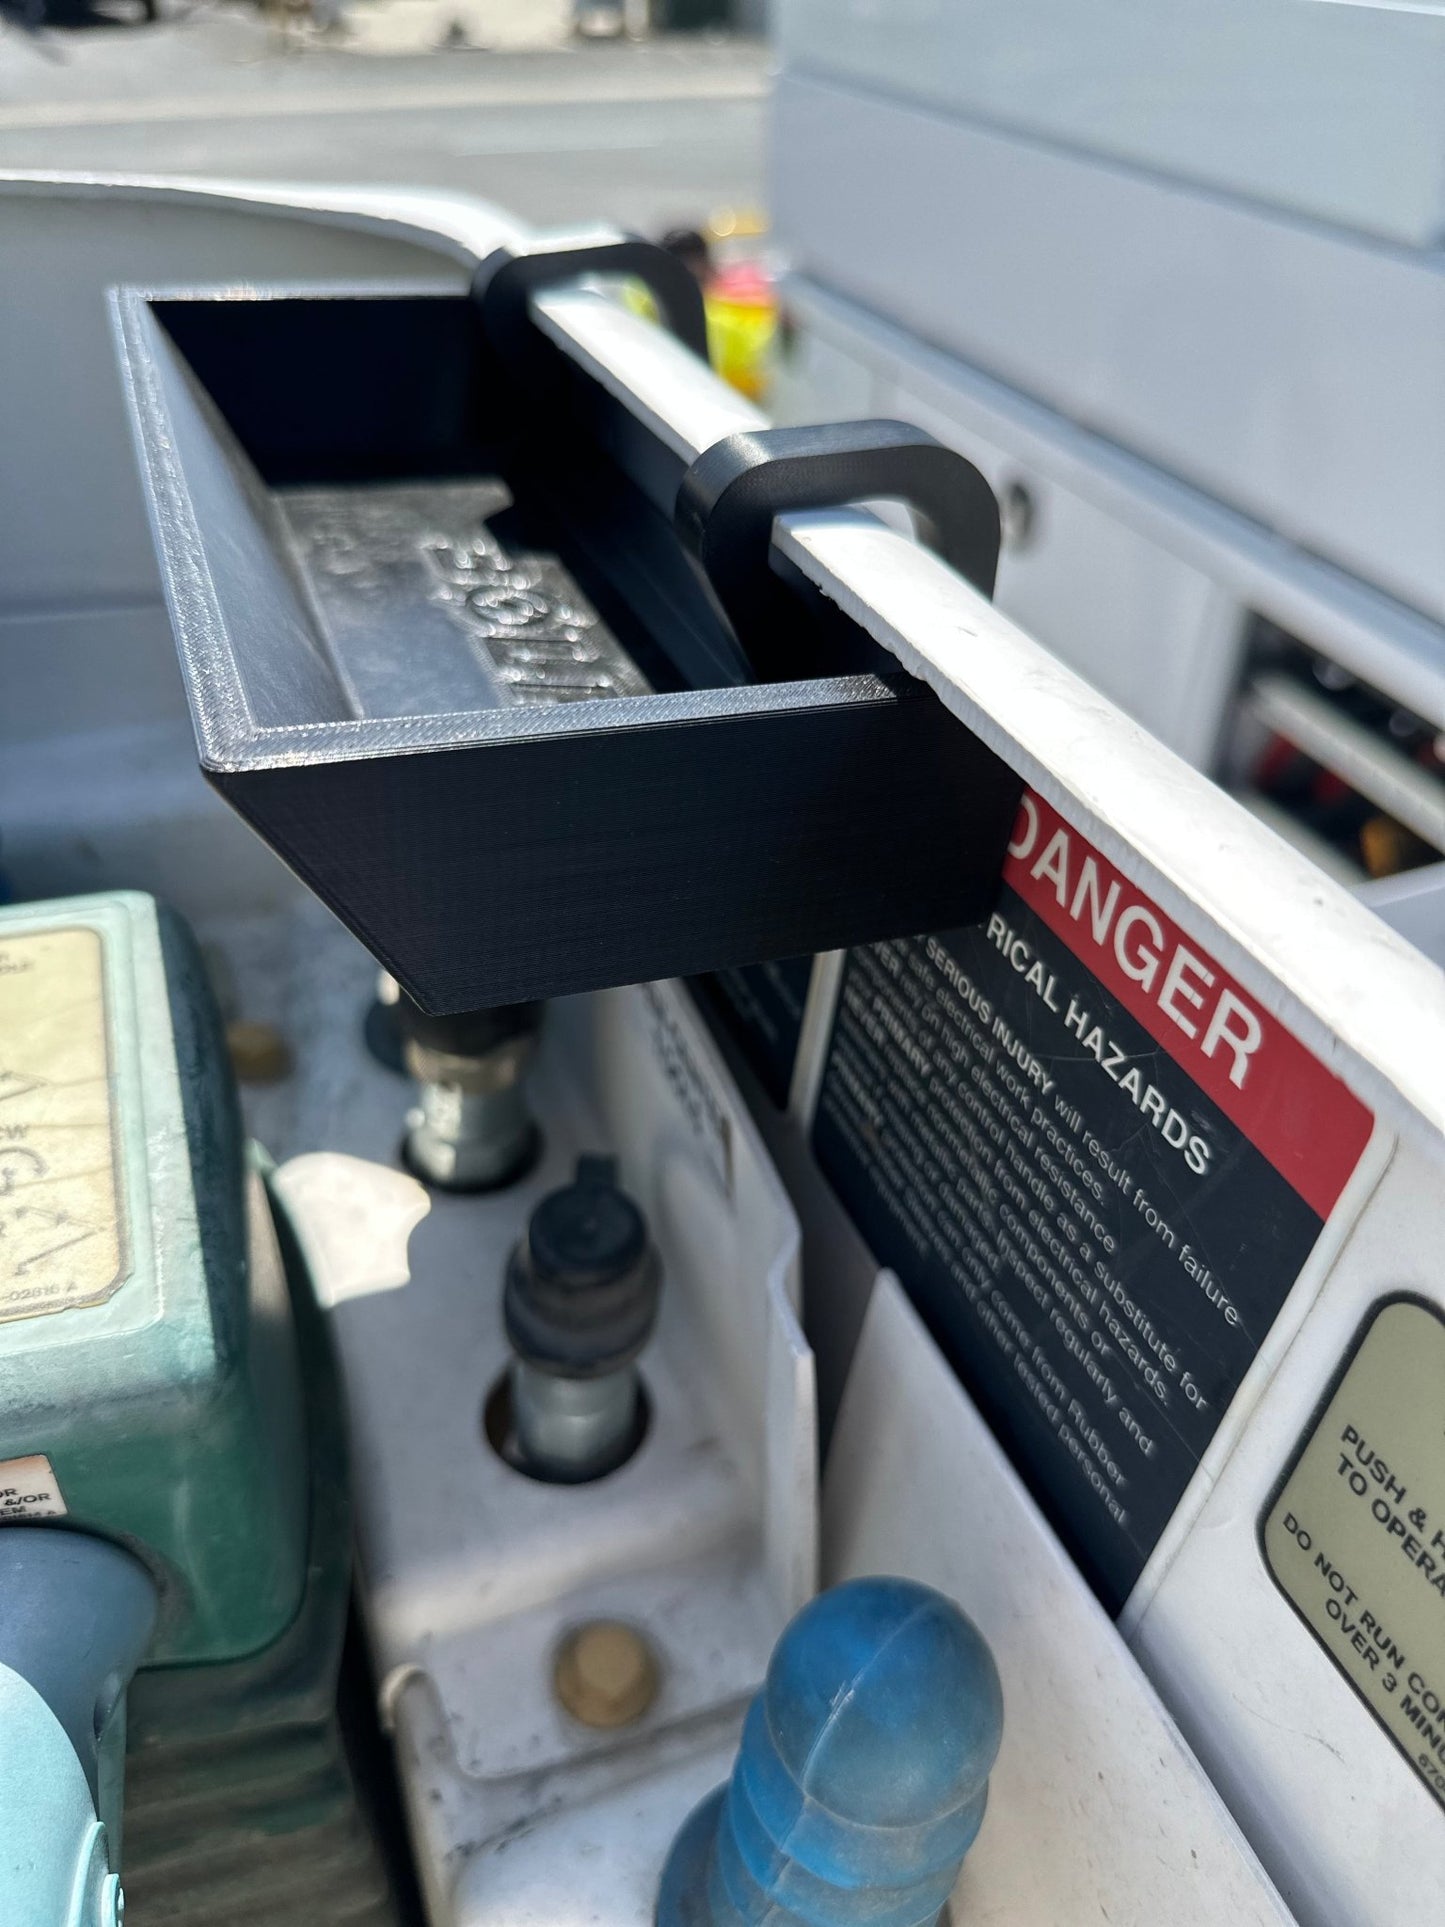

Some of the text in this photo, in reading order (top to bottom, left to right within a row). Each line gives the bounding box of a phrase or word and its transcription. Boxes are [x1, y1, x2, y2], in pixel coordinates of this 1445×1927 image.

[987, 914, 1210, 1174] RICAL HAZARDS
[1008, 794, 1263, 1090] DANGER
[873, 997, 930, 1075] PRIMARY
[929, 1077, 994, 1164] protection
[994, 1159, 1027, 1210] from
[1029, 1210, 1098, 1304] electrical
[1099, 1300, 1167, 1406] hazards.
[909, 954, 1104, 1206] safe electrical work practices.
[921, 1003, 941, 1030] on
[941, 1024, 970, 1068] high
[971, 1066, 1034, 1148] electrical
[1034, 1146, 1116, 1253] resistance
[928, 938, 1240, 1326] SERIOUS INJURY will result from failure
[918, 1030, 935, 1051] of
[932, 1050, 958, 1085] any
[958, 1082, 1005, 1145] control
[1005, 1140, 1055, 1212] handle
[1057, 1213, 1077, 1242] as
[1079, 1242, 1092, 1262] a
[1094, 1261, 1177, 1373] substitute
[1180, 1371, 1207, 1409] for
[927, 1104, 998, 1206] nonmetallic
[1000, 1204, 1090, 1330] components
[1091, 1331, 1111, 1355] or
[962, 1247, 992, 1291] only
[991, 1290, 1032, 1348] come
[1032, 1346, 1067, 1401] from
[1068, 1399, 1125, 1485] Rubber
[977, 1301, 1014, 1352] other
[1014, 1353, 1061, 1423] tested
[1058, 1423, 1126, 1525] personal
[996, 1229, 1050, 1309] Inspect
[1050, 1308, 1118, 1405] regularly
[1119, 1407, 1154, 1456] and
[5, 1493, 52, 1505] &/OR
[1283, 1512, 1312, 1551] DO
[1314, 1552, 1359, 1606] NOT
[1359, 1610, 1406, 1669] RUN
[1337, 1452, 1368, 1496] TO
[1341, 1424, 1407, 1504] PUSH
[1408, 1507, 1427, 1533] &
[1325, 1599, 1380, 1671] OVER
[1382, 1672, 1398, 1693] 3
